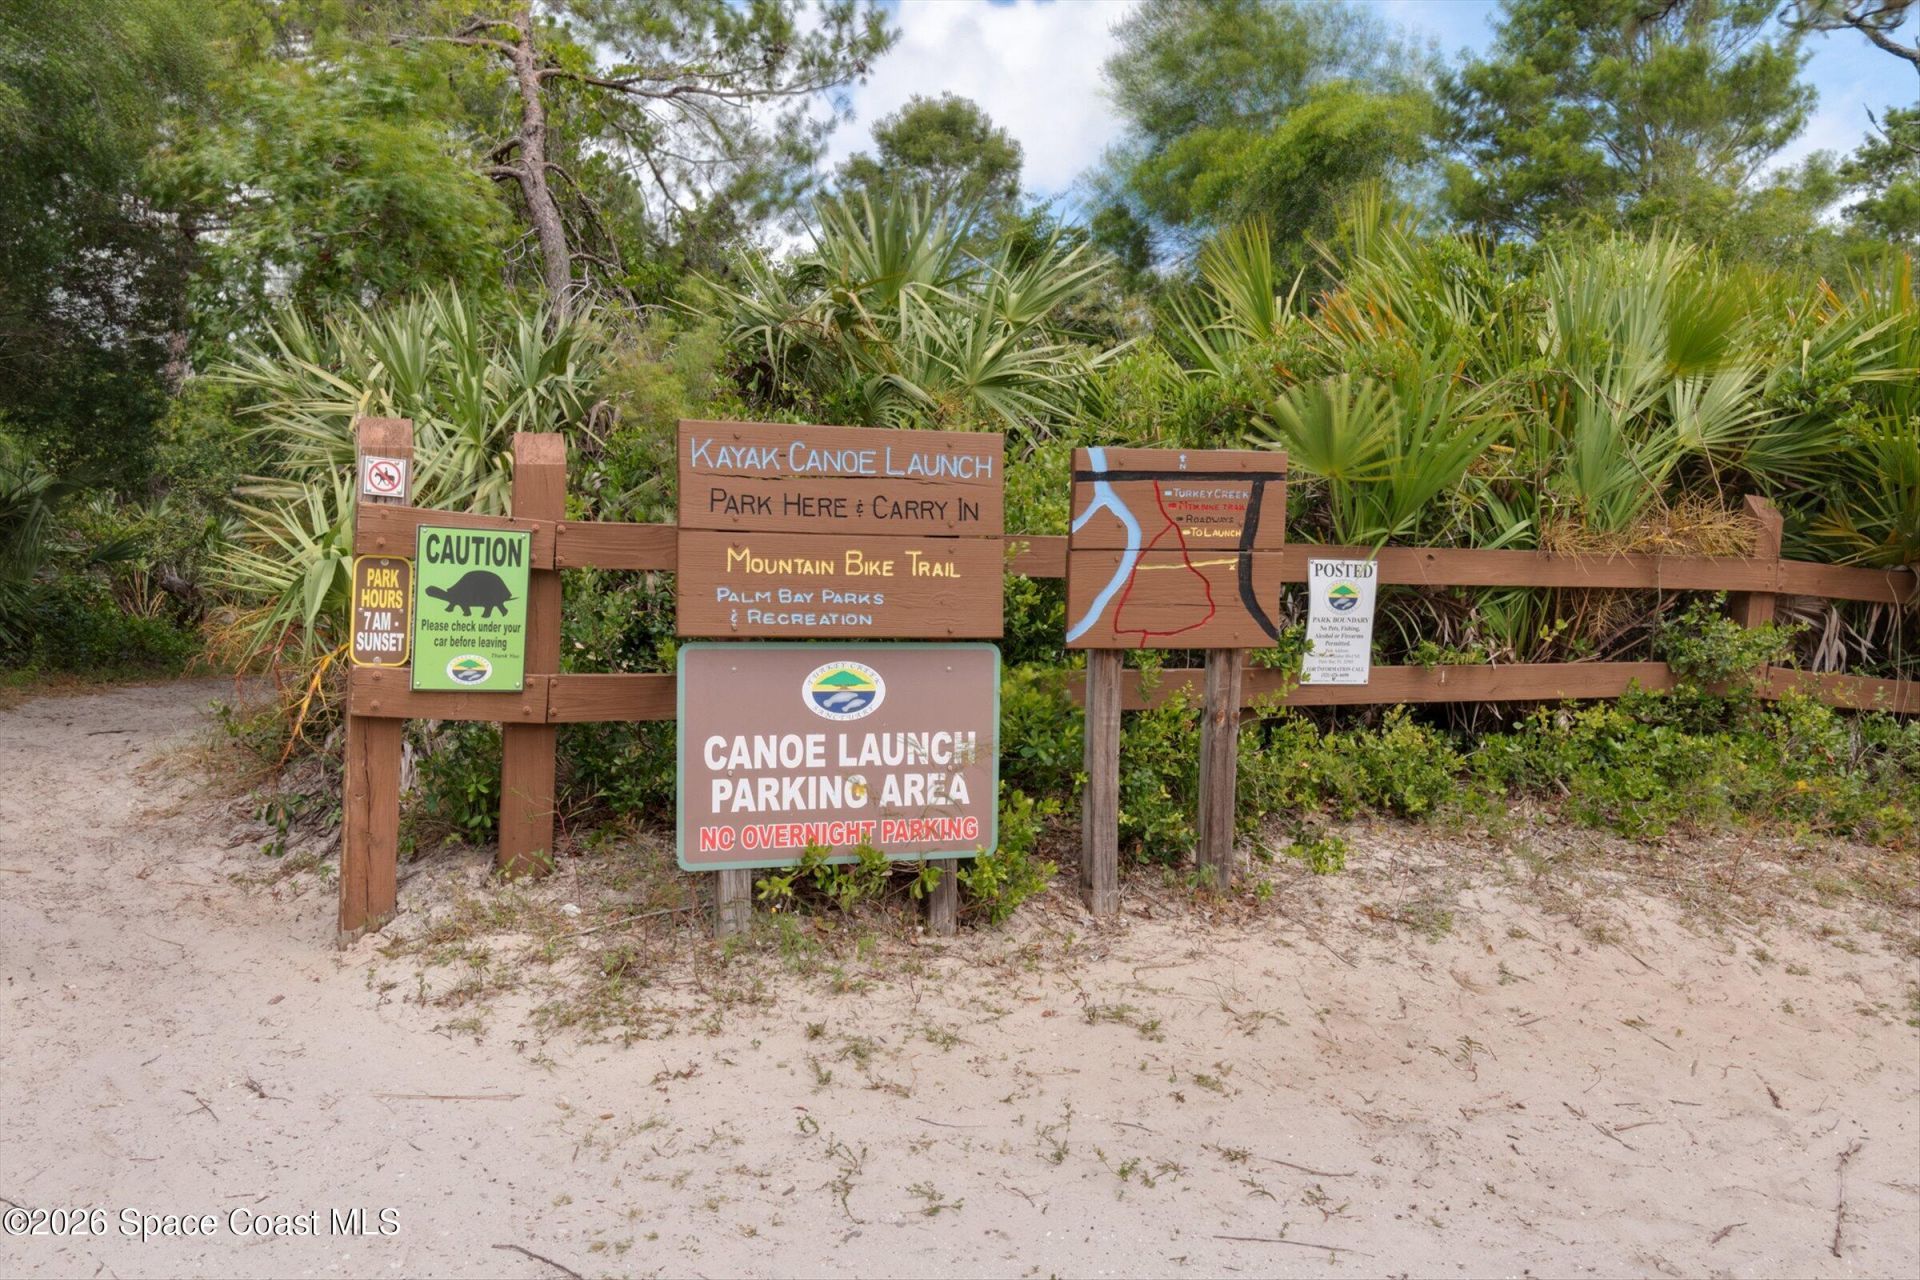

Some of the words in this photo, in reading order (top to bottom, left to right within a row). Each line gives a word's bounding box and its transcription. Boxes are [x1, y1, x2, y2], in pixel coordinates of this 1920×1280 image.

[885, 446, 993, 479] LAUNCH
[1173, 488, 1213, 498] TURKEY
[1214, 488, 1249, 499] CREEK
[710, 487, 772, 516] PARK
[783, 493, 848, 518] HERE
[872, 495, 948, 521] CARRY
[957, 497, 979, 522] IN
[1186, 514, 1234, 524] ROADWAYS
[1203, 527, 1242, 538] LAUNCH
[426, 533, 522, 567] CAUTION
[726, 546, 835, 576] MOUNTAIN
[845, 550, 895, 577] BIKE
[904, 550, 962, 579] TRAIL
[1315, 563, 1373, 578] POSTED
[367, 568, 399, 587] PARK
[361, 589, 403, 609] HOURS
[716, 586, 773, 604] PALM
[777, 588, 814, 604] BAY
[821, 589, 885, 606] PARKS
[421, 618, 450, 632] Please
[451, 619, 477, 633] check
[478, 620, 502, 634] under
[503, 622, 521, 635] your
[747, 609, 873, 626] RECREATION
[1332, 616, 1369, 624] BOUNDARY
[356, 632, 405, 651] SUNSET
[433, 637, 448, 648] car
[450, 636, 477, 649] before
[478, 636, 508, 651] leaving
[703, 733, 827, 771] CANOE
[838, 731, 977, 767] LAUNCH
[711, 774, 869, 813] PARKING
[879, 772, 971, 807] AREA
[700, 826, 736, 851] NO
[741, 820, 877, 850] OVERNIGHT
[881, 815, 979, 843] PARKING
